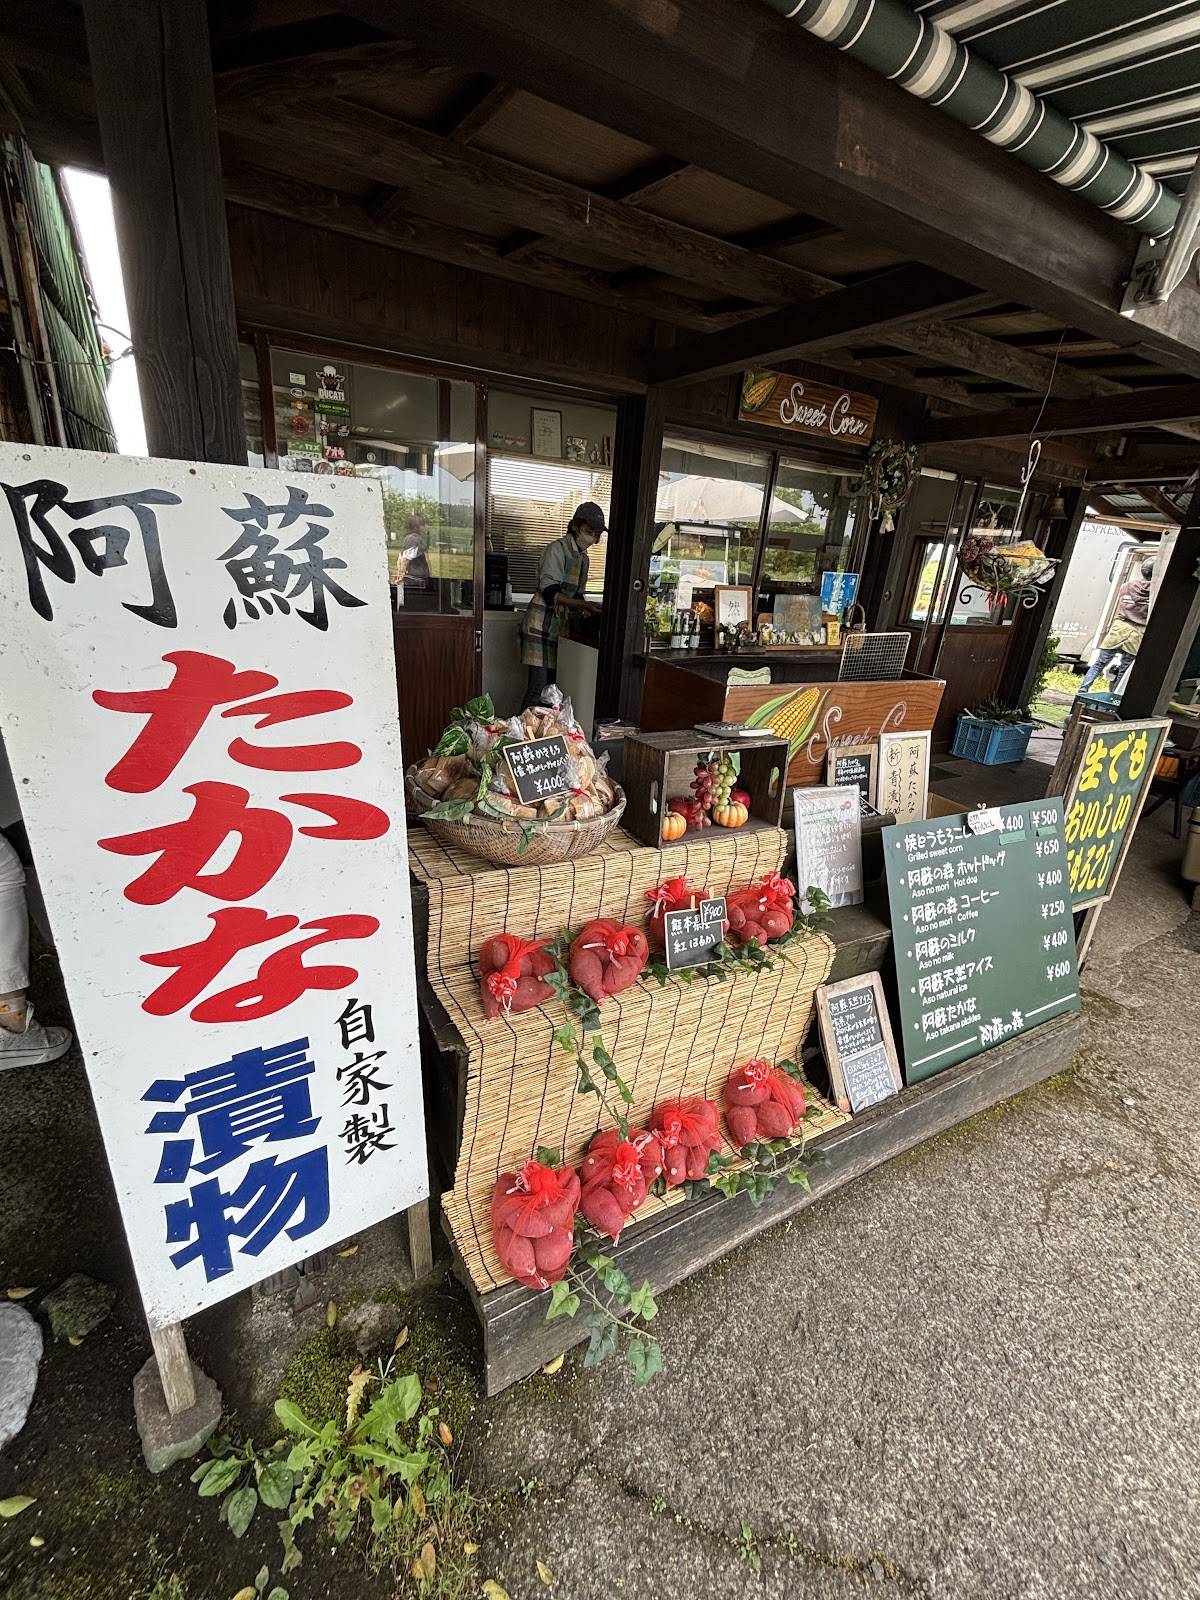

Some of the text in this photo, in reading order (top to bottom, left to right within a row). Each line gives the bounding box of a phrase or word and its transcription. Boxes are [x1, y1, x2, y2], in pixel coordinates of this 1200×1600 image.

[318, 388, 345, 401] DUCATI
[780, 382, 868, 435] Sweet Corn
[0, 478, 369, 631] 阿蘇
[1079, 731, 1148, 792] 生でも
[92, 650, 391, 1024] たかな
[1032, 809, 1058, 828] ¥500
[1065, 793, 1132, 844] おいしい
[907, 845, 963, 862] Grilled sweet corn
[907, 839, 1060, 889] 阿蘇の森 ホットドッグ ¥650
[911, 876, 978, 899] Aso no mori Hot dog
[911, 869, 1062, 925] 阿蘇の森 コーヒー ¥400
[915, 910, 979, 935] Aso no mori Coffee
[915, 899, 1065, 961] 阿蘇のミルク ¥250
[918, 930, 1068, 997] 阿蘇天然アイス ¥400
[919, 951, 955, 970] Aso no milk
[921, 960, 1071, 1033] 阿蘇たかな ¥600
[922, 984, 968, 1007] Aso natural ice
[925, 1013, 981, 1042] Aso takana pickles
[334, 997, 398, 1165] 自家製
[141, 1036, 331, 1284] 漬物
